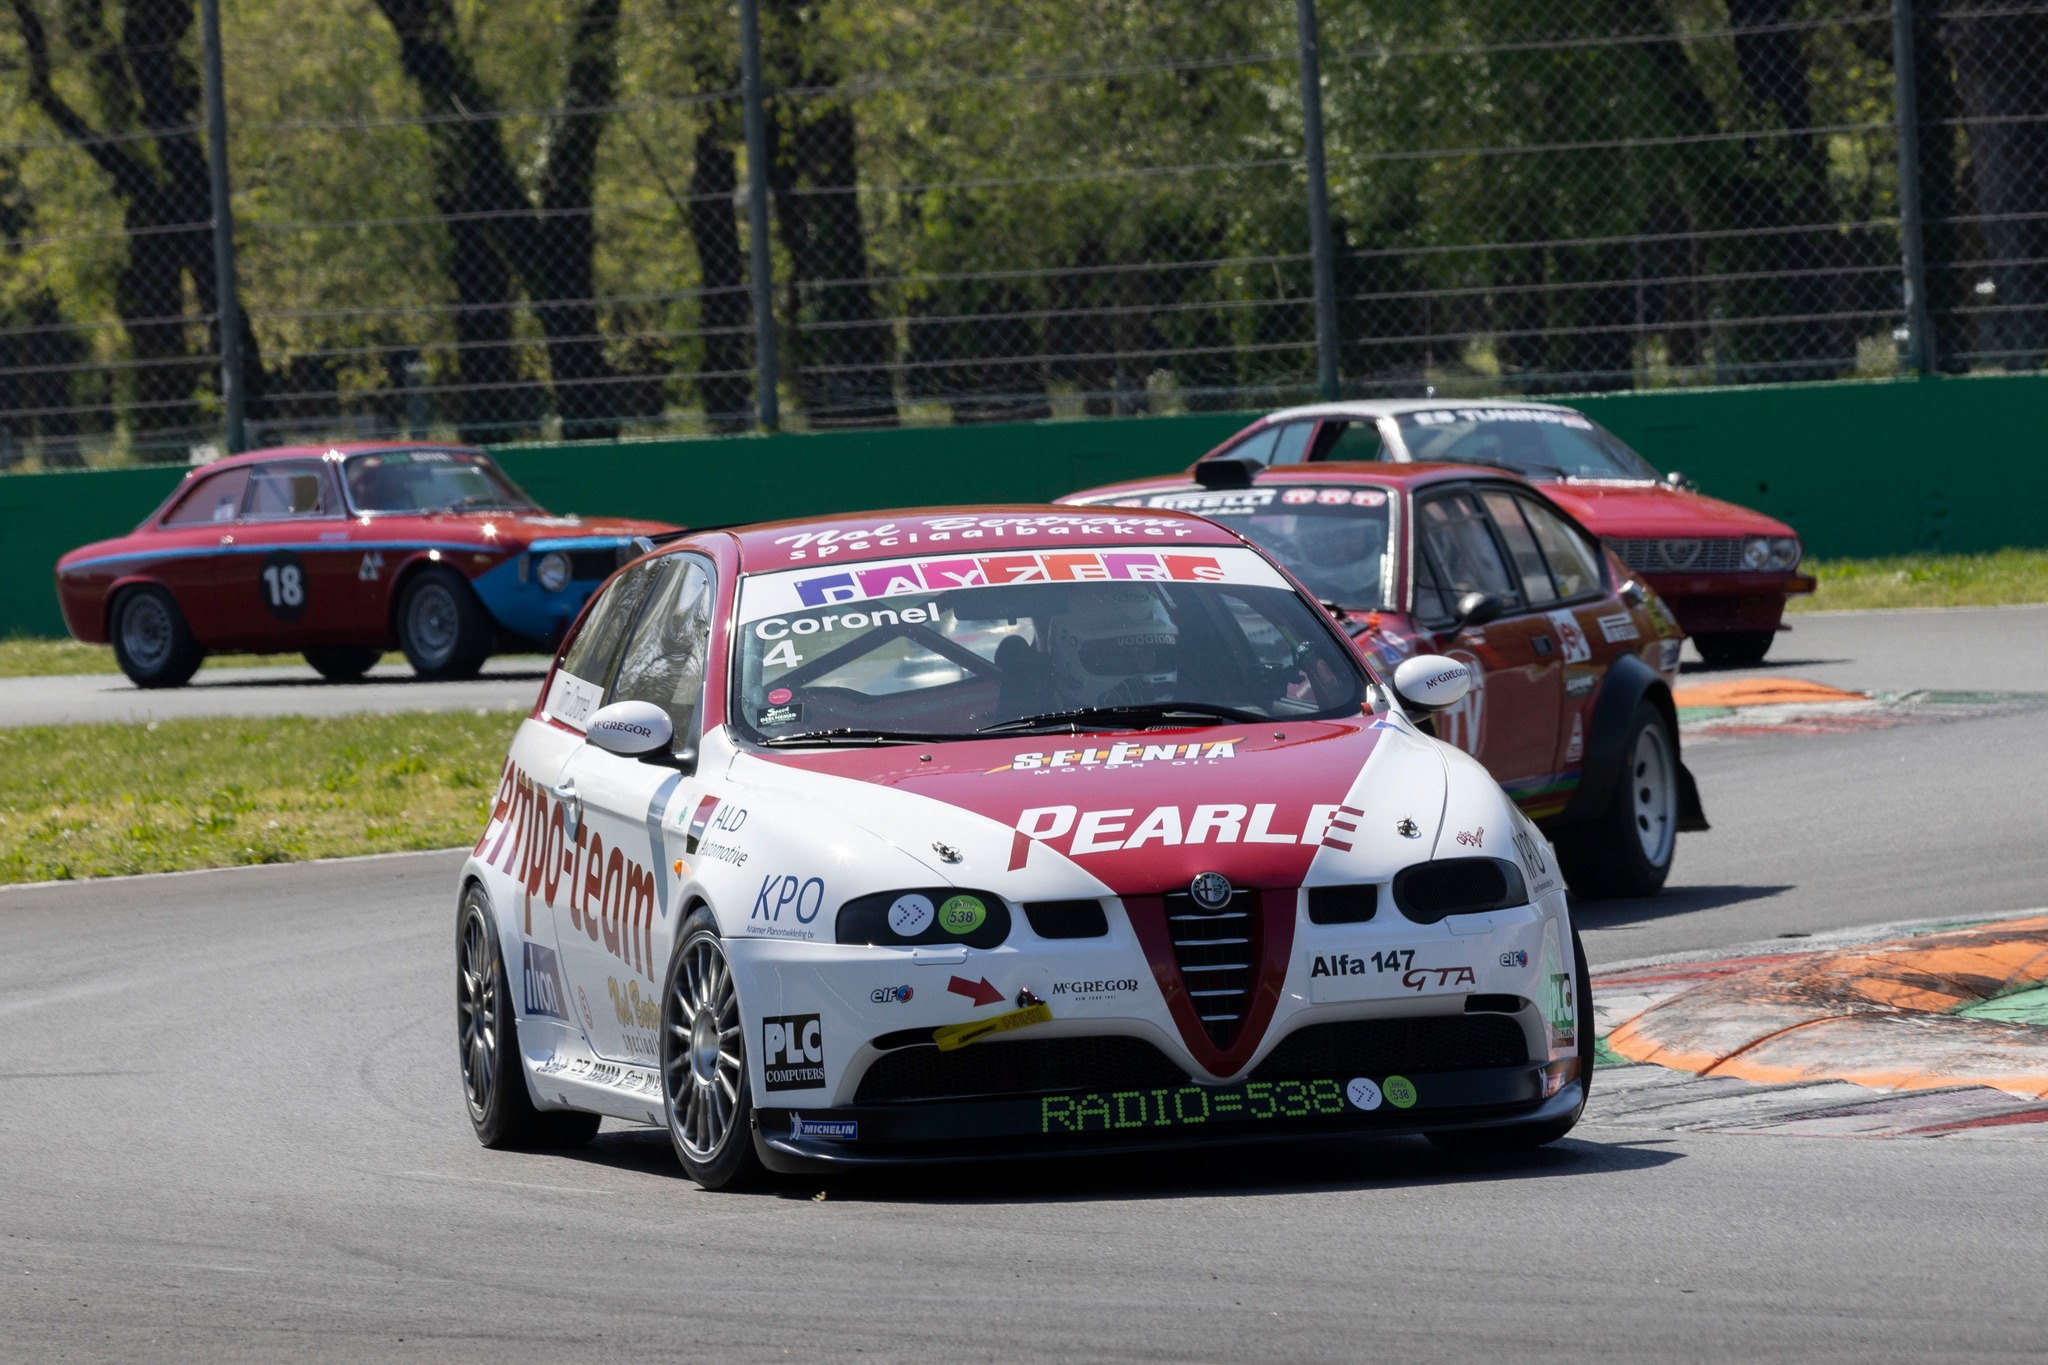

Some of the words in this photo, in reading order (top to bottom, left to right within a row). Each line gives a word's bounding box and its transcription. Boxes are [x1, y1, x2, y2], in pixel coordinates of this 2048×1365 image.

[1148, 489, 1276, 509] PIRELLI
[775, 524, 901, 545] Nol
[789, 525, 1193, 560] speciaalbakker
[264, 564, 303, 606] 18
[821, 563, 1224, 601] DAYZERS
[756, 602, 940, 640] Coronel
[763, 639, 803, 668] 4
[593, 720, 651, 738] McGREGOR
[1034, 763, 1145, 775] MOTOR
[711, 805, 748, 832] ALD
[1007, 803, 1365, 872] PEARLE
[698, 837, 748, 867] Automotive
[473, 755, 654, 984] empo-team
[751, 874, 825, 924] KPO
[949, 911, 973, 923] 538
[1311, 954, 1366, 978] Alfa
[1371, 950, 1416, 973] 147
[1500, 951, 1521, 968] elf
[1052, 979, 1138, 994] McGREGOR
[1402, 966, 1476, 992] GTA
[871, 986, 899, 1003] elf
[764, 1020, 822, 1065] PLC
[766, 1067, 824, 1083] COMPUTERS
[1042, 1078, 1344, 1133] RADIO=538
[1392, 1089, 1409, 1100] 538
[804, 1123, 855, 1135] MICHELIN
